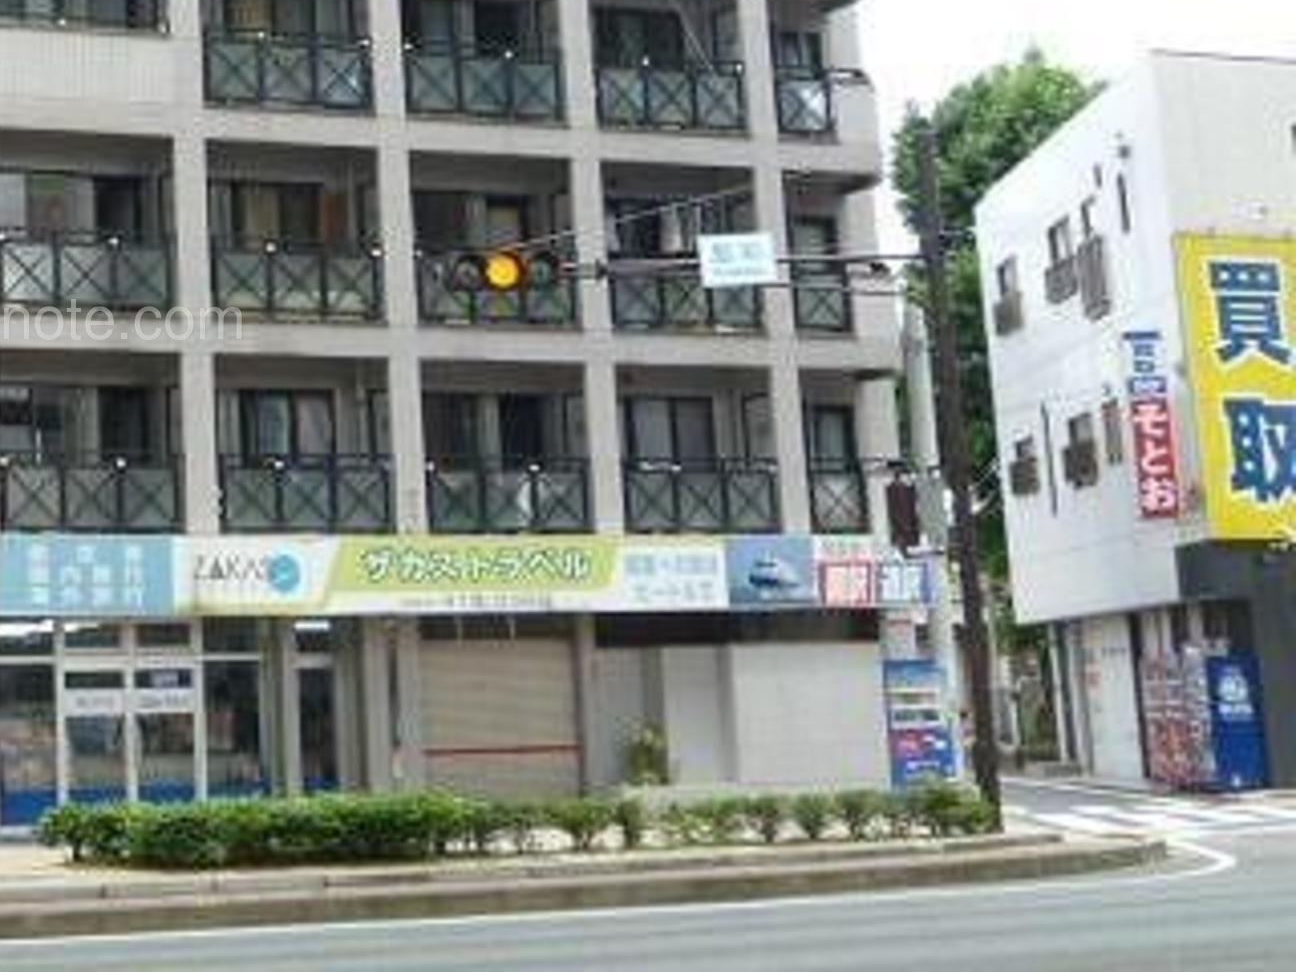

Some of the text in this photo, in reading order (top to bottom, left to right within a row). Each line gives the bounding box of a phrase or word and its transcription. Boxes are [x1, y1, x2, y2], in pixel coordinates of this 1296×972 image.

[361, 547, 591, 583] ザカストラベル
